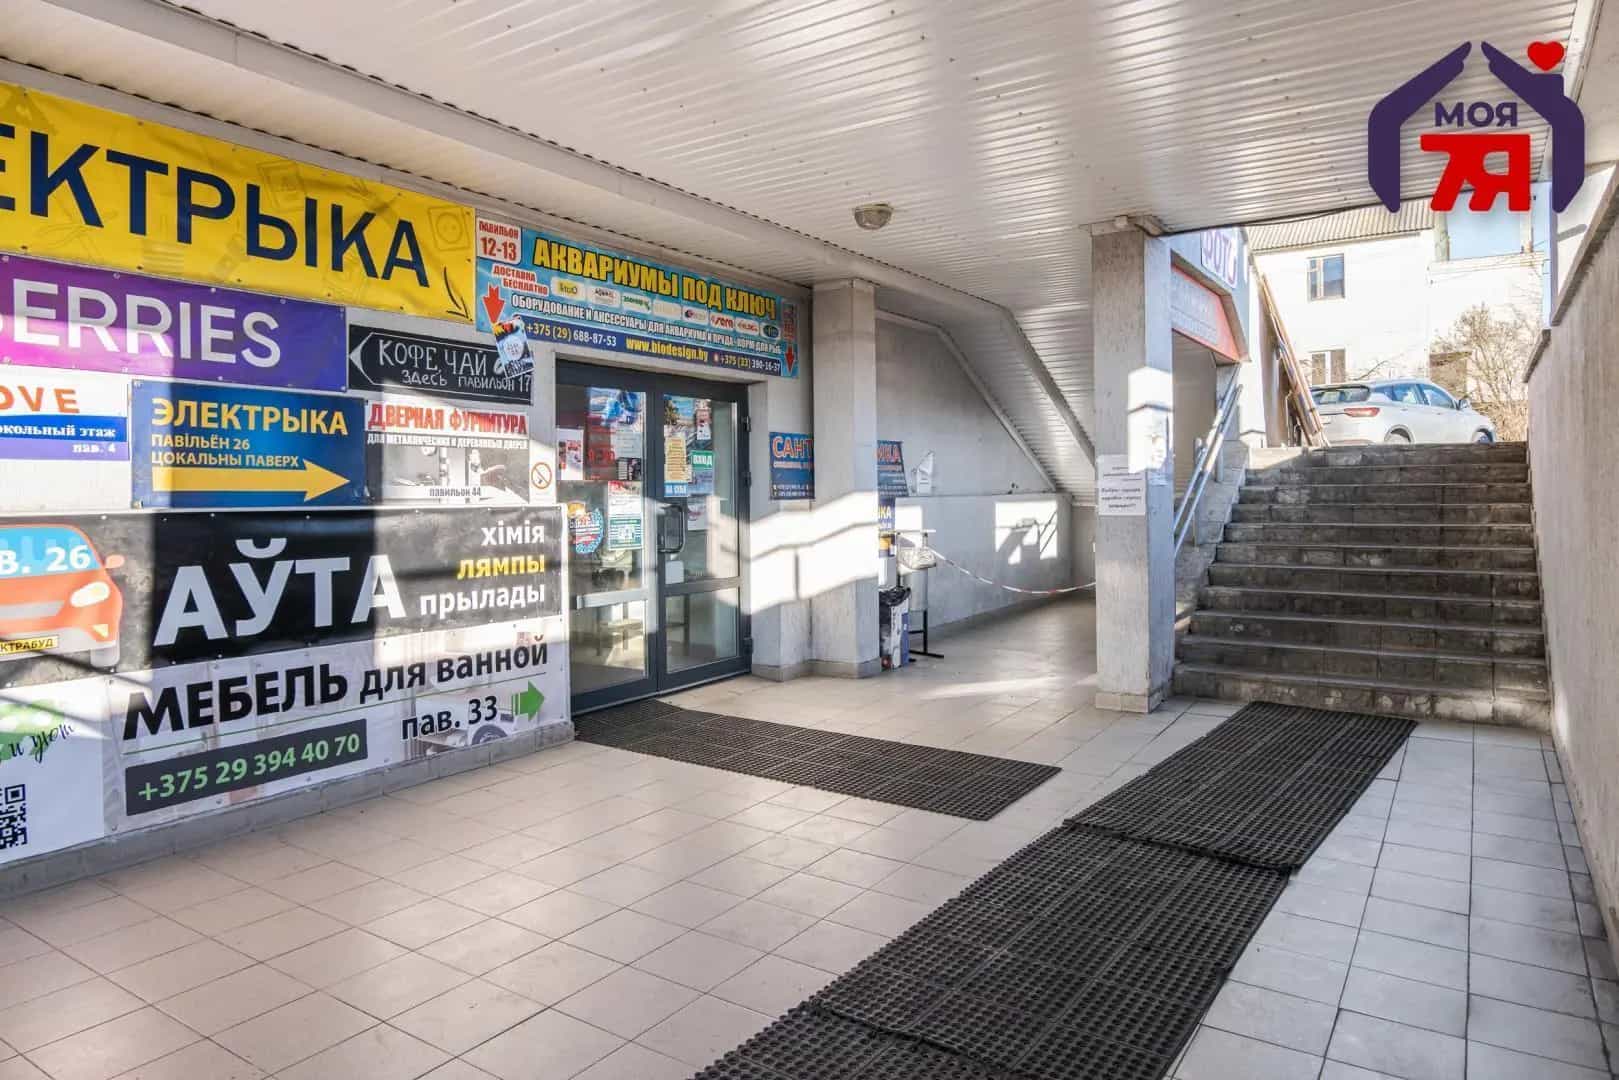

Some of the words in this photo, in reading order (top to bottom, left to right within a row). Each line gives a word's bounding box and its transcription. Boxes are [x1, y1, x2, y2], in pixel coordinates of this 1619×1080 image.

[478, 220, 519, 240] ПАВИЛЬОН
[480, 236, 517, 262] 12-13
[493, 264, 536, 283] ДОСТАВКА
[503, 277, 549, 296] БЕСПЛАТНО
[533, 236, 679, 298] АКВАРИУМЫ
[682, 274, 723, 312] ПОД
[725, 286, 778, 320] КЛЮЧ
[0, 277, 282, 369] ERRIES
[511, 293, 585, 321] ОБОРУДОВАНИЕ
[593, 309, 646, 331] АКСЕССУАРЫ
[526, 322, 551, 337] +375
[552, 325, 572, 343] (29)
[444, 350, 488, 377] ЧАЙ
[625, 338, 709, 363] www.biodesign.by
[517, 375, 532, 393] 17
[151, 397, 349, 436] ЭЛЕКТРЫКА
[367, 403, 445, 431] ДВЕРНАЯ
[450, 407, 528, 435] ФУРНИТУРА
[0, 424, 77, 437] кольный
[79, 427, 117, 438] этаж
[151, 433, 231, 449] ПАВІЛЬЁН
[233, 438, 250, 451] 26
[151, 451, 242, 467] ЦОКАЛЬНЫ
[245, 455, 299, 468] ПАВЕРХ
[429, 487, 470, 497] павильон
[471, 487, 482, 497] 44
[481, 519, 546, 547] хімія
[45, 545, 91, 573] 26
[456, 554, 546, 581] лямпы
[152, 537, 408, 648] АЎТА
[419, 583, 546, 621] прылады
[123, 663, 349, 741] МЕБЕЛЬ
[359, 662, 427, 705] для
[436, 633, 549, 684] ванной
[401, 708, 461, 741] пав.
[468, 694, 498, 726] 33
[138, 765, 209, 802] +375
[214, 758, 248, 785] 29
[253, 746, 297, 777] 394
[300, 740, 330, 765] 40
[334, 733, 361, 758] 70
